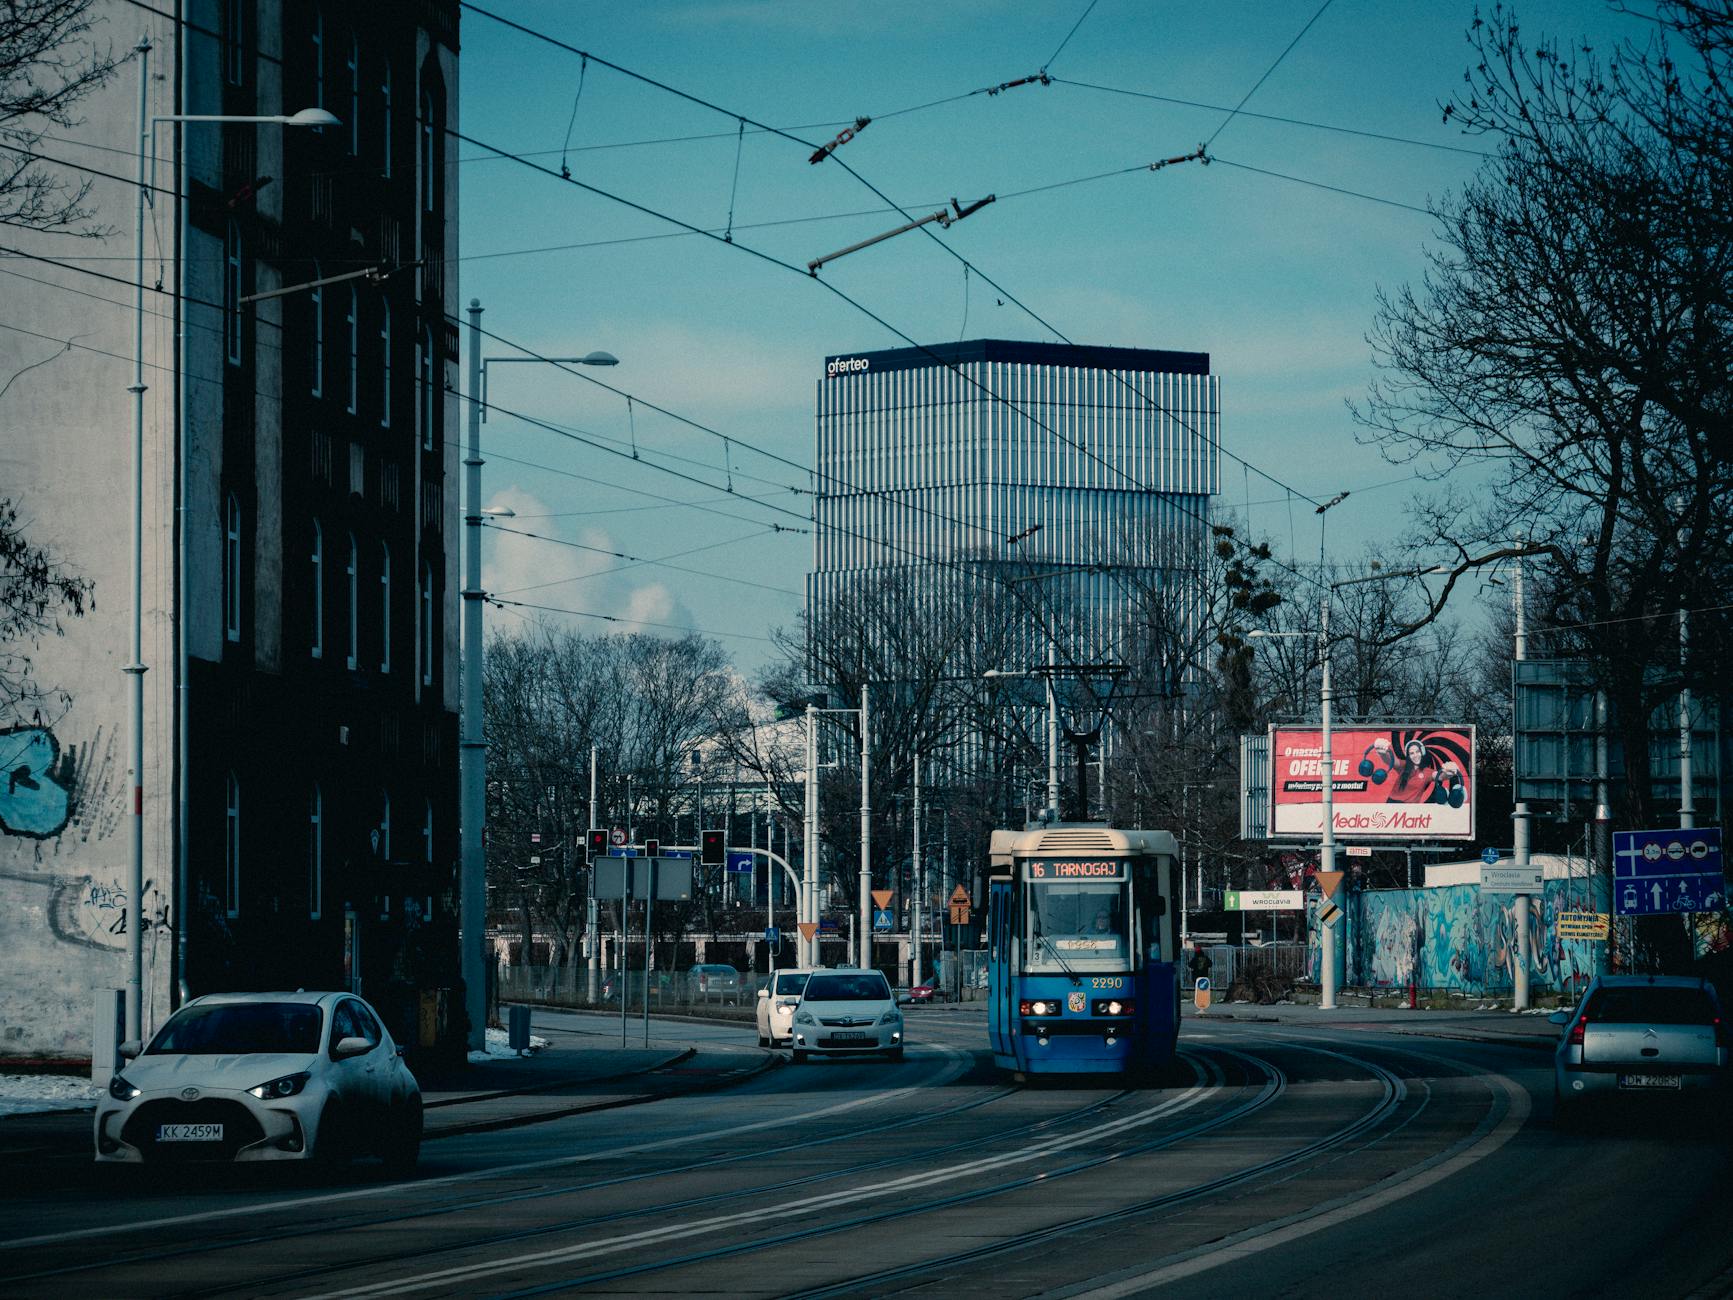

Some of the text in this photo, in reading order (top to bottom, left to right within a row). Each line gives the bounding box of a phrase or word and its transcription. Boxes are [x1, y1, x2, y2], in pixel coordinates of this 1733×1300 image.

[828, 357, 869, 374] oferteo
[1285, 746, 1322, 758] O naszej
[1386, 812, 1431, 828] Markt
[1032, 862, 1116, 877] 16 TARNOGAJ
[1034, 952, 1040, 961] 3
[1092, 977, 1123, 989] 2290
[1627, 1074, 1642, 1085] DW
[164, 1126, 220, 1138] KK 2459M
